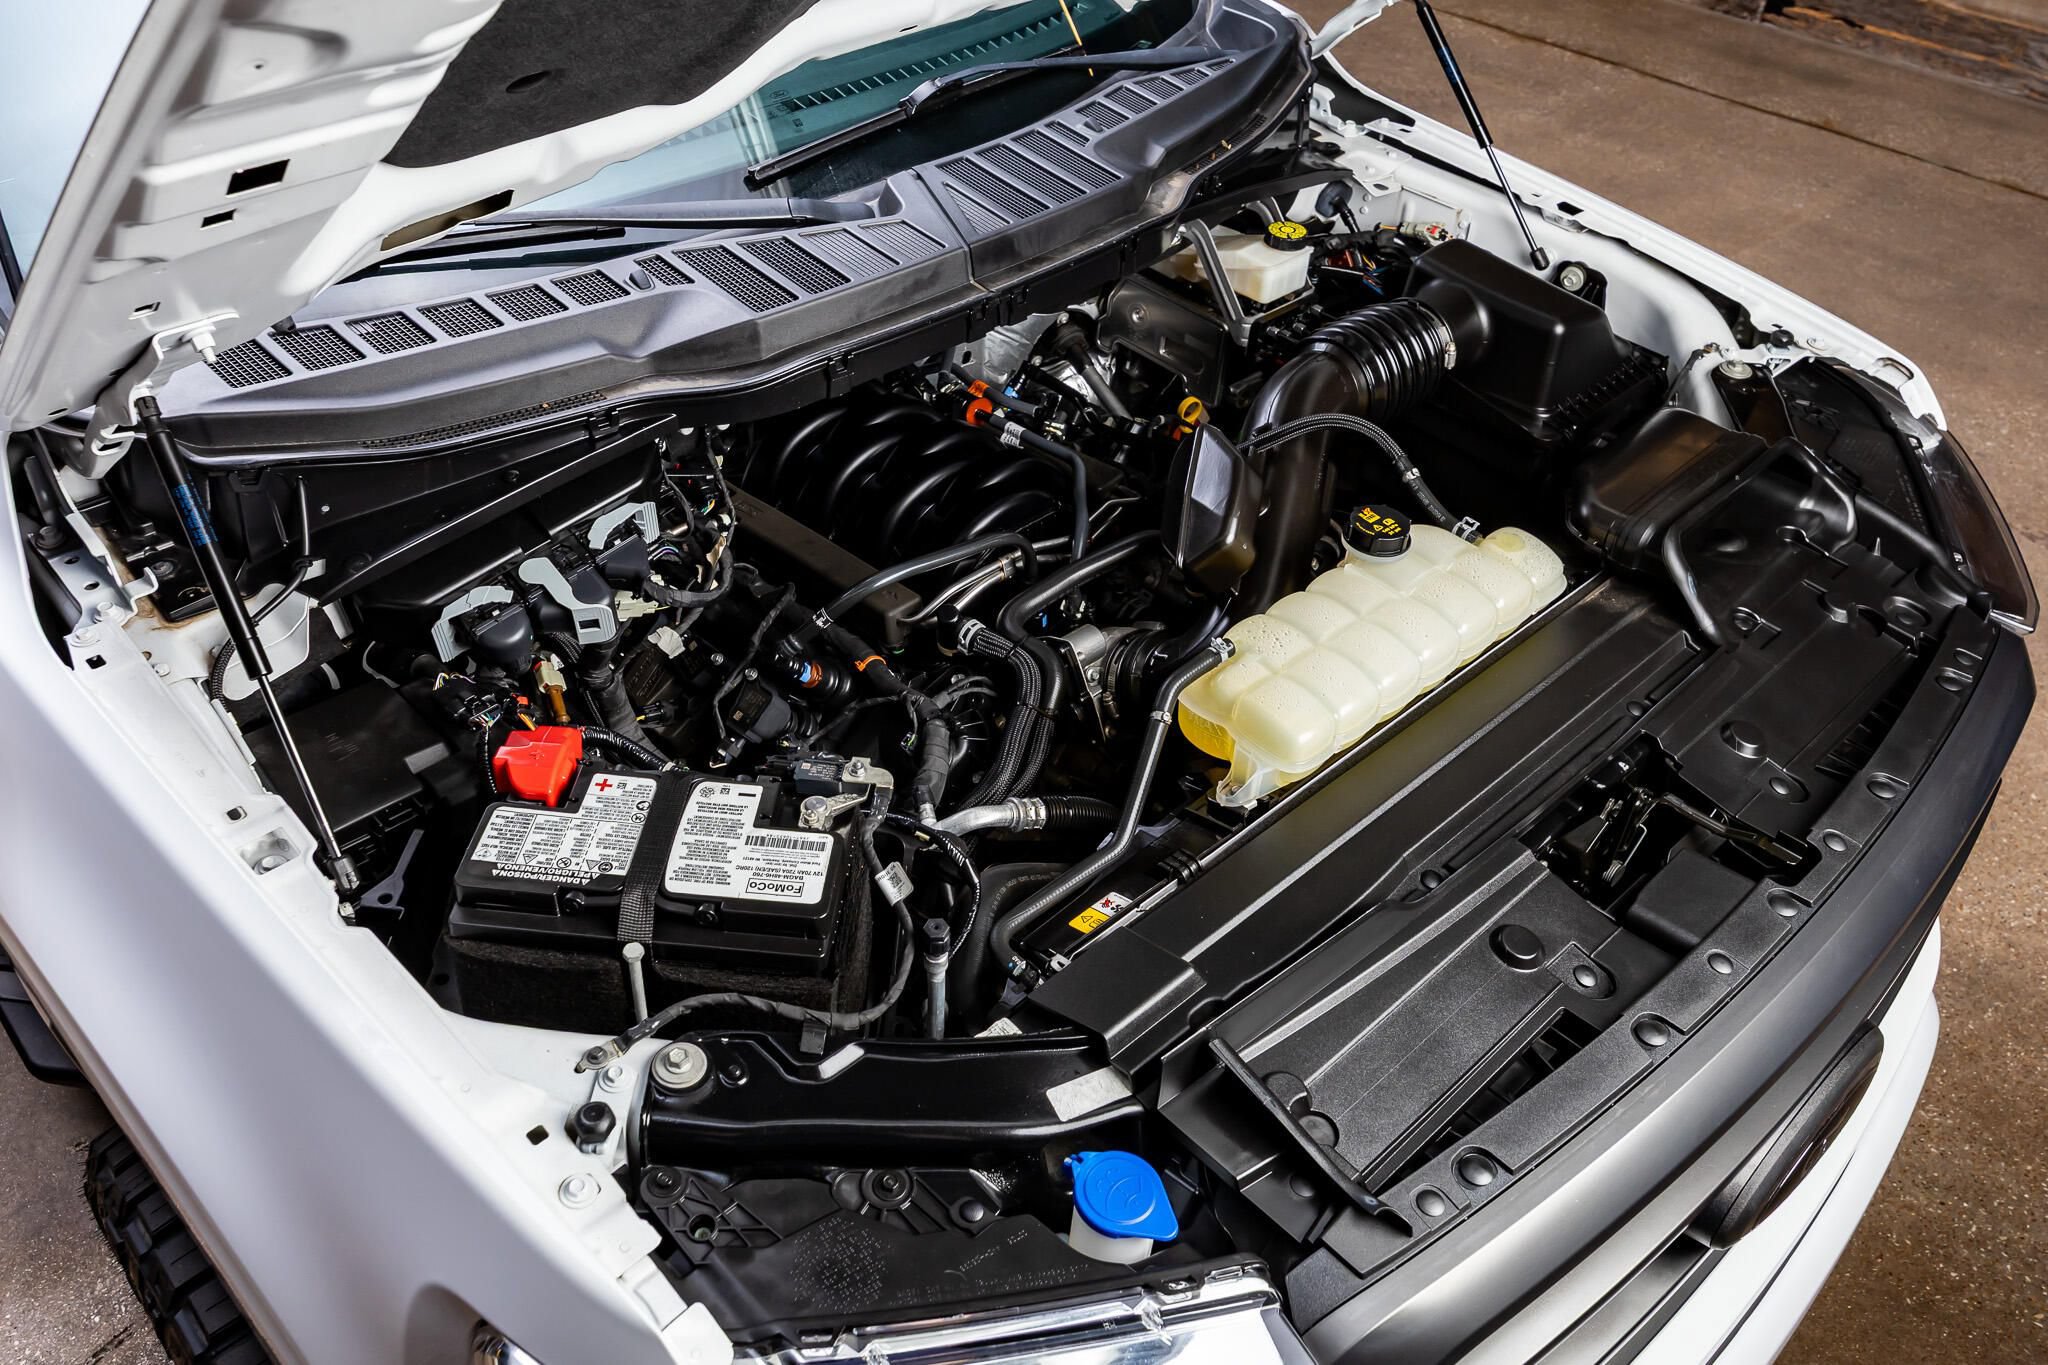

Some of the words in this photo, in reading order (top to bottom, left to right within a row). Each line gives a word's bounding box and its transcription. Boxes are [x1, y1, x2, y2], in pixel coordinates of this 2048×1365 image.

[503, 863, 591, 877] PELIGRO/VENENO
[751, 871, 803, 880] BAGM-48H6-760
[498, 870, 580, 883] DANGER/POISON
[748, 881, 801, 893] FoMoCo
